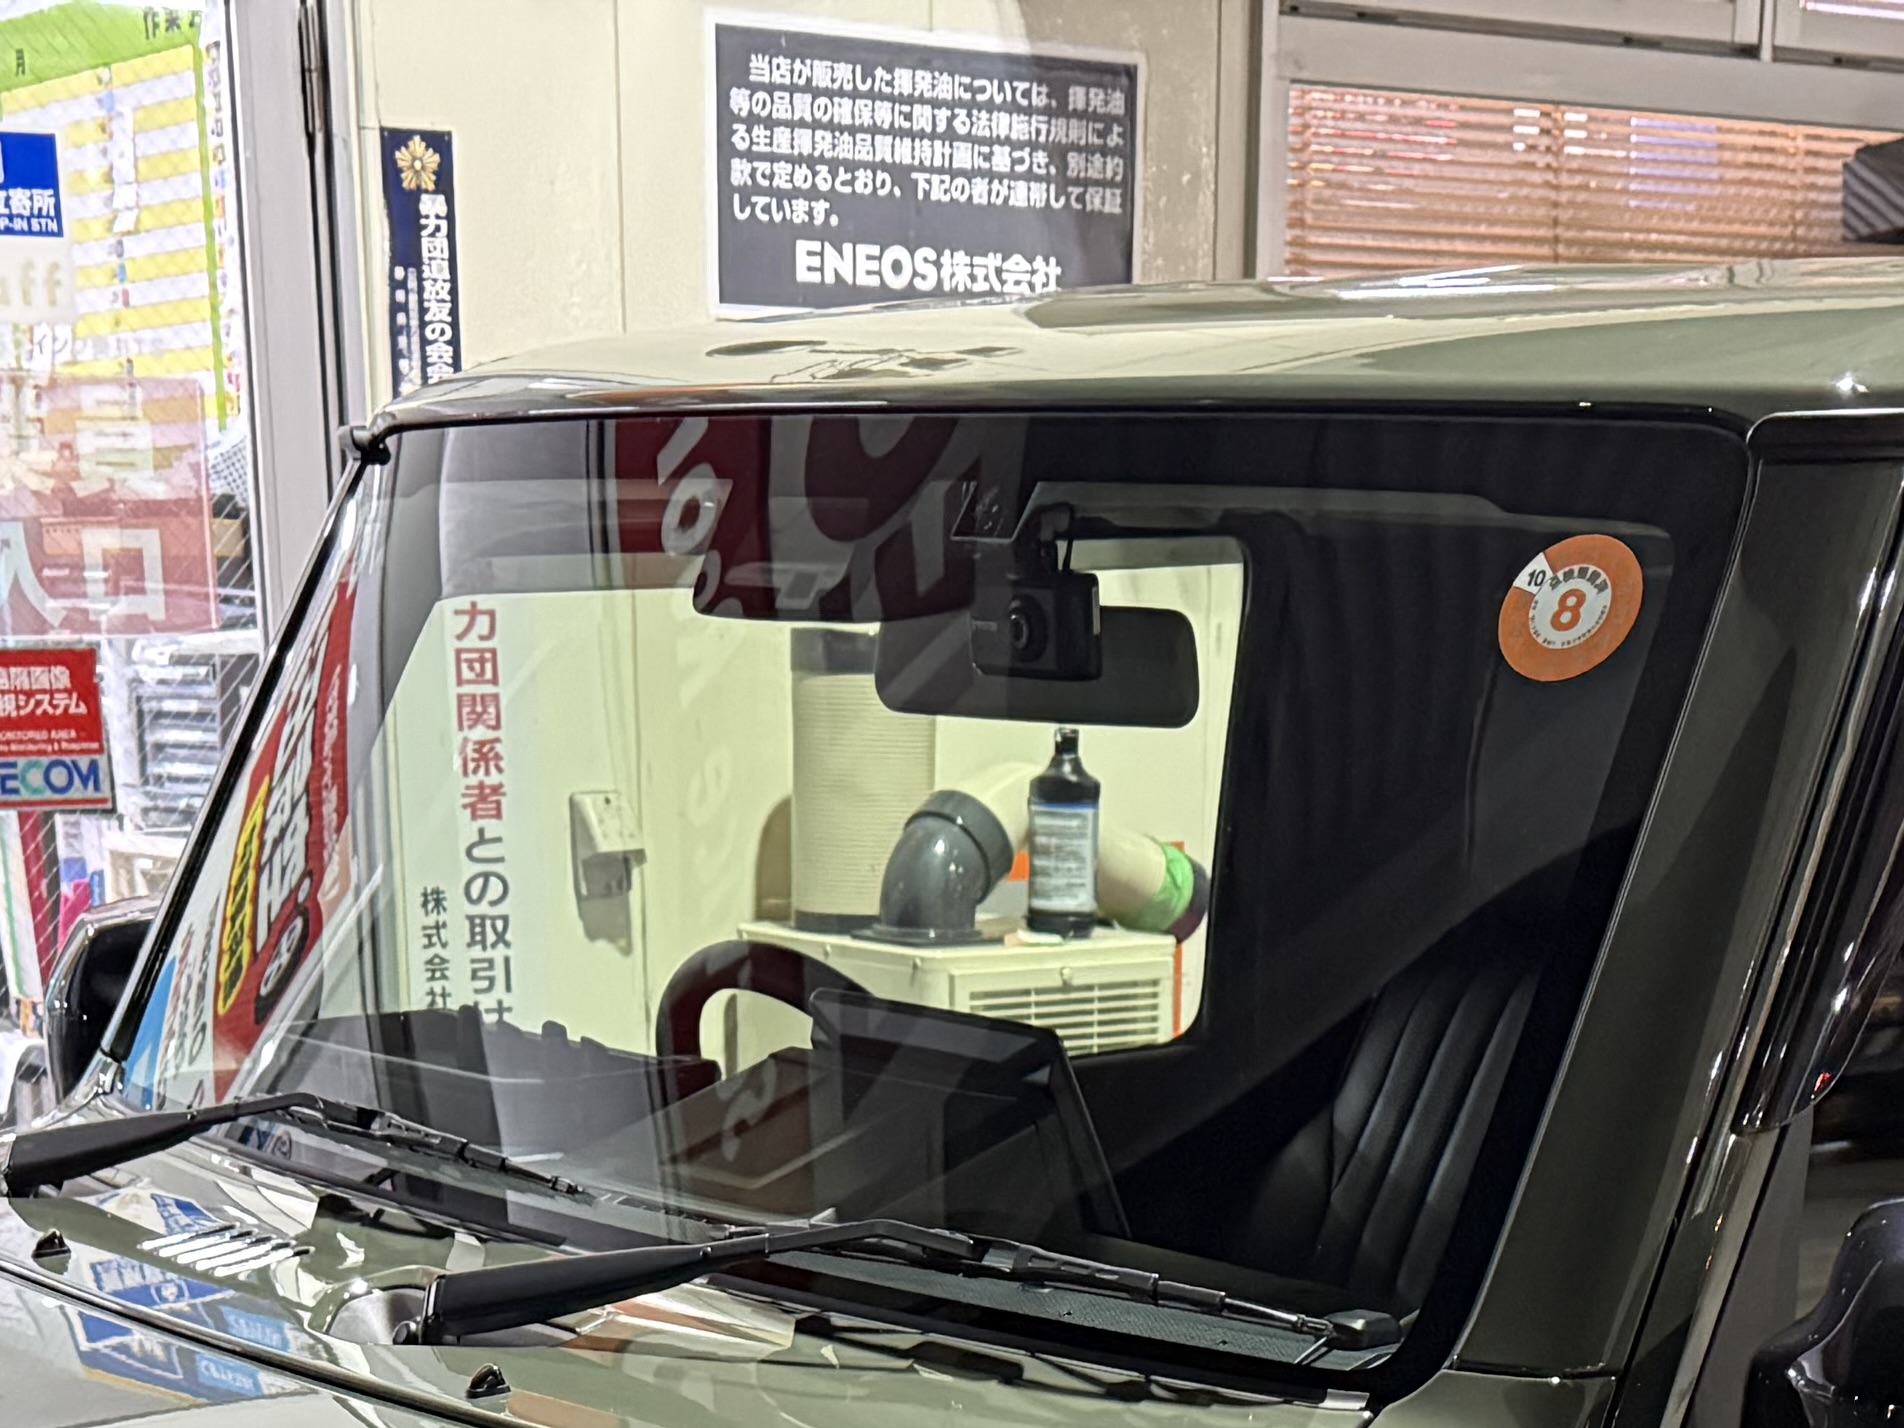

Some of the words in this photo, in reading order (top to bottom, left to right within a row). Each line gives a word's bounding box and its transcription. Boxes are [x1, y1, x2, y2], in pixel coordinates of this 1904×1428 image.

[30, 217, 59, 233] STN
[732, 193, 840, 228] しています。
[794, 238, 1064, 296] ENEOS株式会社
[1527, 568, 1547, 588] 10
[1549, 587, 1588, 632] 8
